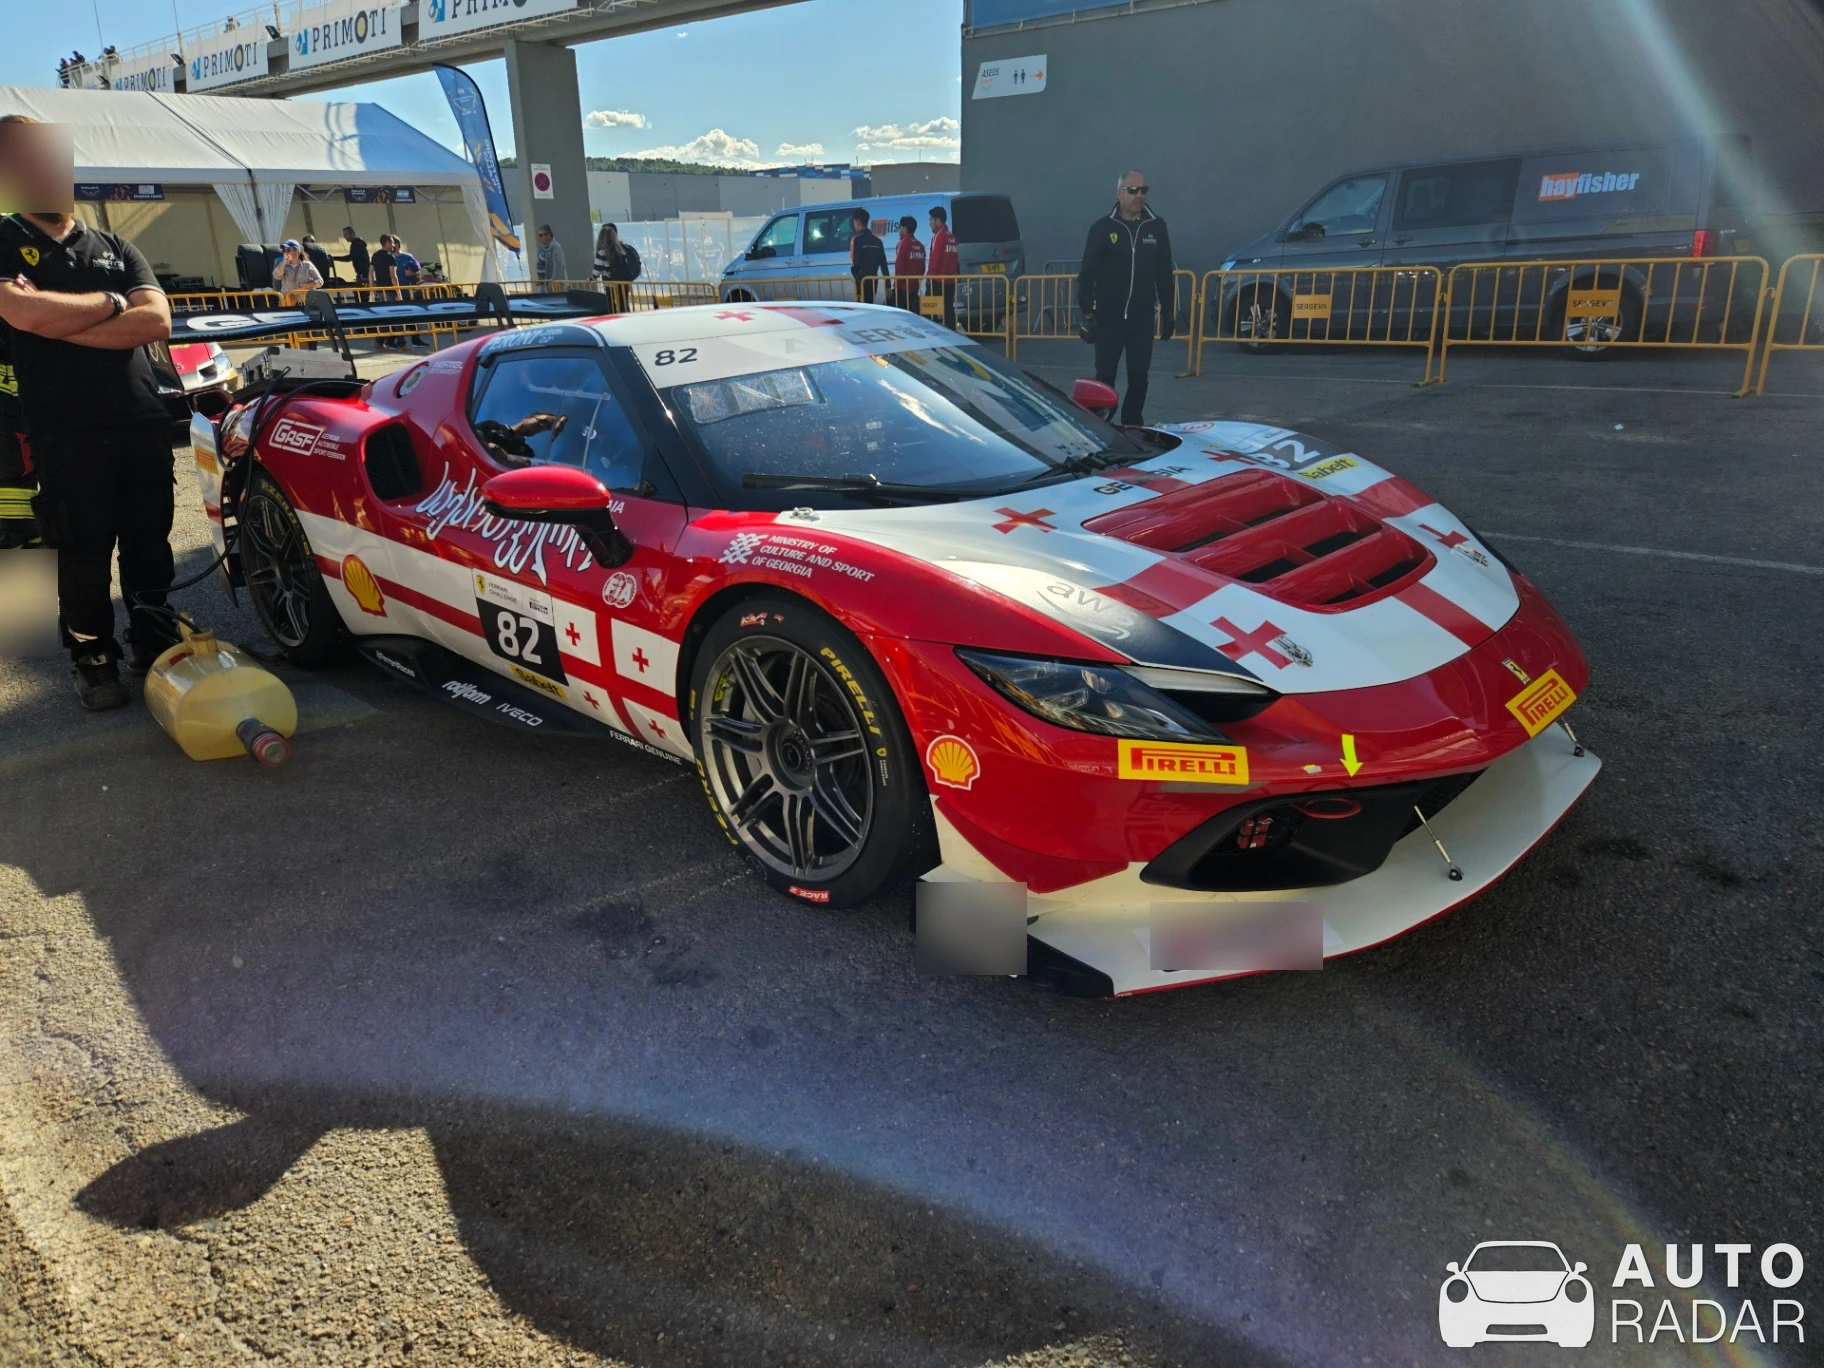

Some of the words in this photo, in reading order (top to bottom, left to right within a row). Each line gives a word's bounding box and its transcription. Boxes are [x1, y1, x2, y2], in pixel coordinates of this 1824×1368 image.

[312, 7, 387, 53] PRIMOTI
[203, 41, 258, 78] PRIMOTI
[1540, 171, 1640, 198] hayfisher
[654, 347, 698, 367] 82
[274, 424, 315, 448] GASF
[768, 535, 819, 550] MINISTRY
[818, 544, 838, 555] OF
[751, 556, 766, 566] OF
[766, 557, 813, 578] GEORGIA
[759, 545, 807, 561] CULTURE
[806, 554, 833, 568] AND
[831, 561, 875, 582] SPORT
[497, 611, 543, 665] 82
[820, 647, 881, 735] PIRELLI
[1516, 677, 1569, 727] PIRELLI
[496, 702, 544, 727] IVECO
[609, 729, 645, 750] FERRARI
[644, 744, 683, 766] GENUINE
[1130, 747, 1237, 775] PIRELLI
